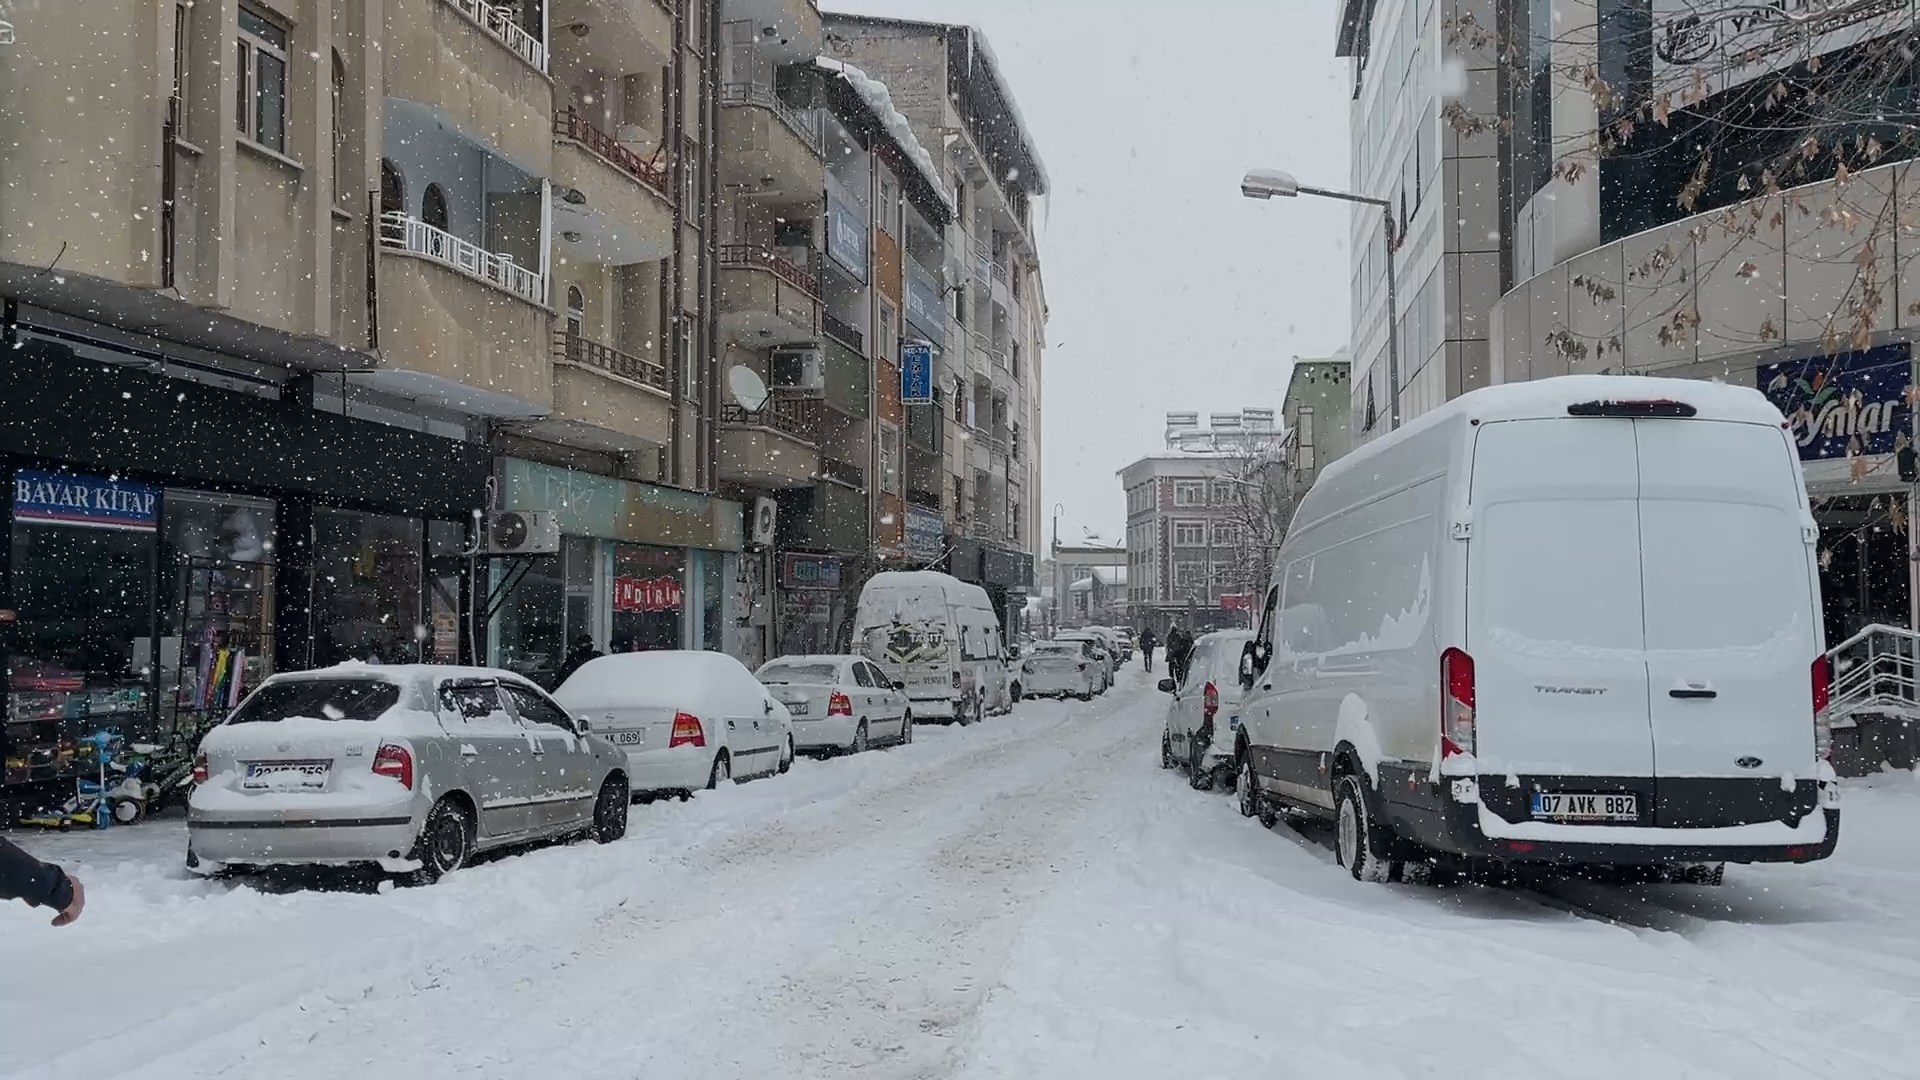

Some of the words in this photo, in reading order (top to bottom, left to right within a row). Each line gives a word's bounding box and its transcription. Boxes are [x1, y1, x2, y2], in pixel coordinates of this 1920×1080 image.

[16, 479, 89, 507] BAYAR
[95, 484, 155, 514] KİTAP
[614, 581, 681, 606] İNDİRİM
[1533, 685, 1608, 696] TRANSIT
[620, 733, 638, 743] 069
[1542, 795, 1561, 813] 07
[1568, 796, 1597, 814] AVK
[1605, 797, 1635, 815] 882
